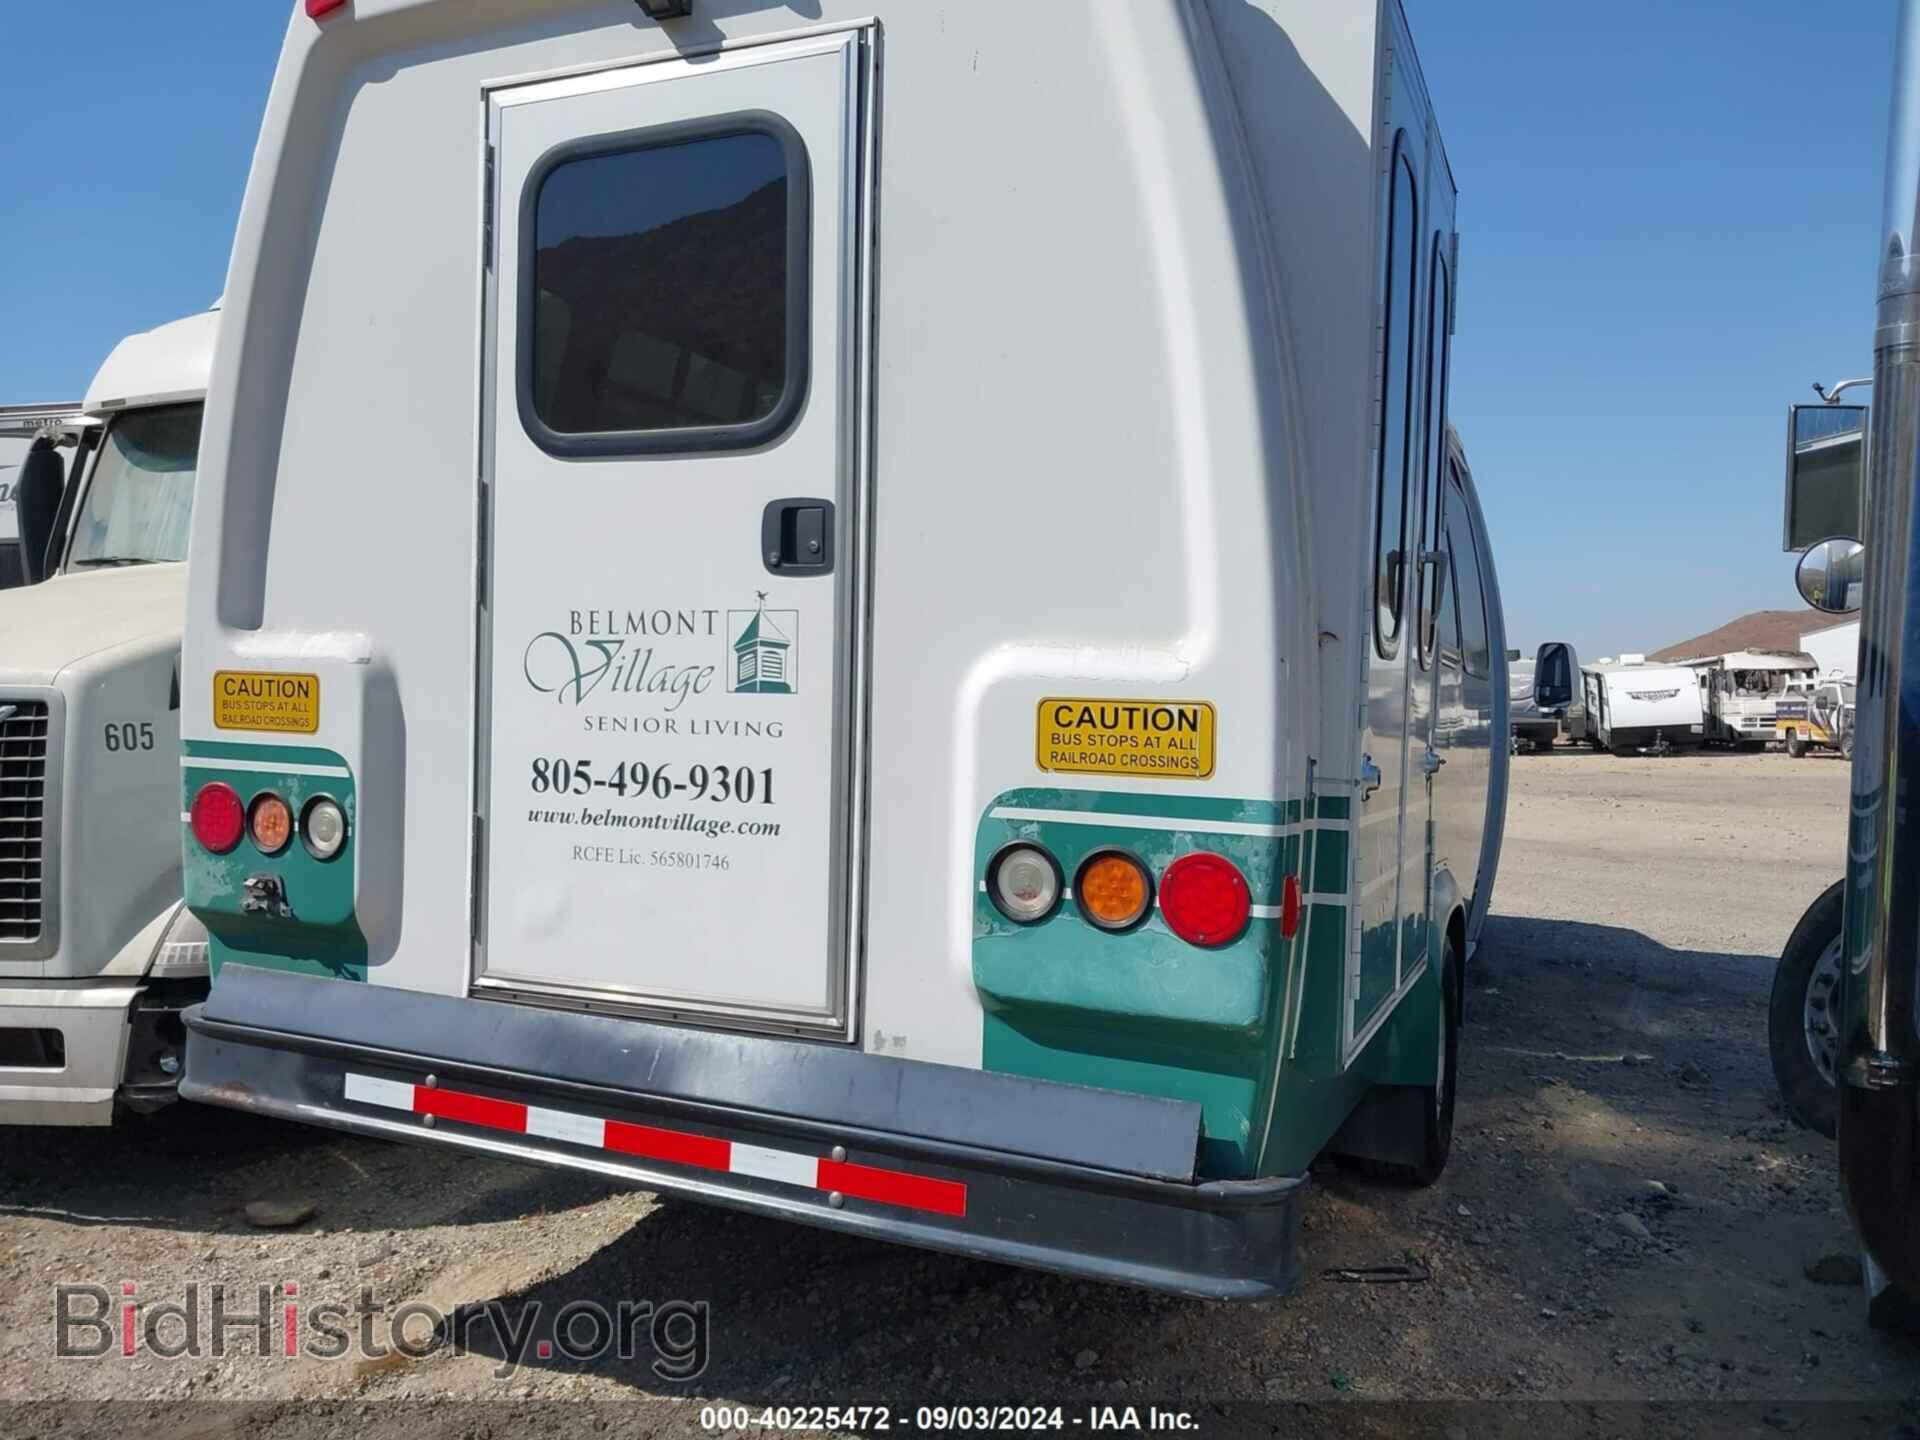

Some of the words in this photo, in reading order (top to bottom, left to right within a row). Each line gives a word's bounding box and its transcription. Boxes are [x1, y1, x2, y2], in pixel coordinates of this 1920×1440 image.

[570, 609, 719, 636] BELMONT
[524, 632, 716, 712] Village
[224, 678, 310, 698] CAUTION
[222, 700, 241, 711] BUS
[243, 700, 275, 712] STOPS
[277, 702, 289, 712] AT
[290, 702, 310, 713] ALL
[1054, 705, 1198, 732] CAUTION
[222, 713, 263, 725] RAILROAD
[264, 715, 310, 728] CROSSINGS
[583, 715, 680, 734] SENIOR
[690, 719, 784, 738] LIVING
[104, 722, 155, 751] 605
[1051, 733, 1082, 746] BUS
[1087, 734, 1139, 748] STOPS
[1143, 736, 1161, 749] AT
[1167, 737, 1197, 751] ALL
[1050, 751, 1116, 766] RAILROAD
[1119, 753, 1199, 769] CROSSINGS
[531, 757, 776, 804] 805-496-9301
[527, 808, 781, 838] www.belmontvillage.com
[572, 845, 615, 864] RCFE
[618, 847, 646, 865] Lic.
[649, 850, 730, 871] 565801746
